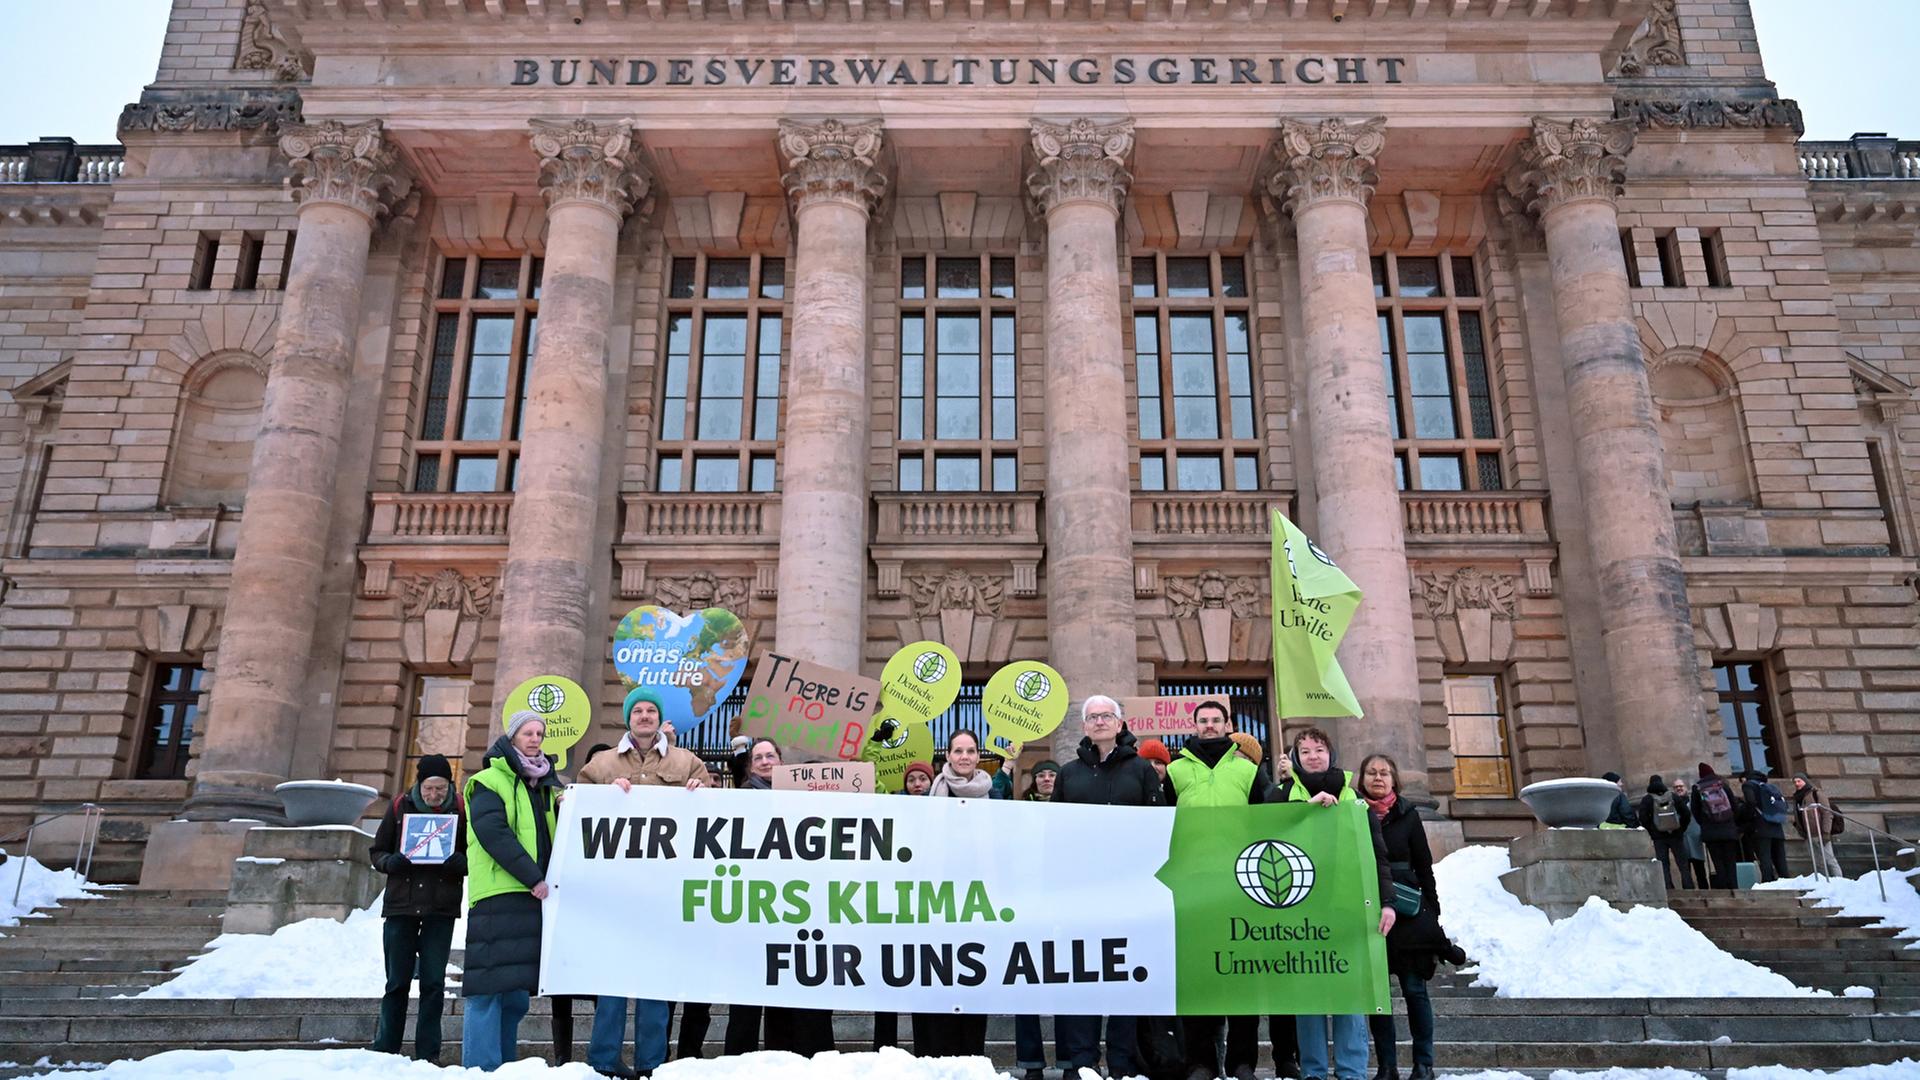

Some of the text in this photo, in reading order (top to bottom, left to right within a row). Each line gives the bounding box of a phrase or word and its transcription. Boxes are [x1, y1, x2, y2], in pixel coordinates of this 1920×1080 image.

[511, 58, 1405, 86] BUNDESVERWALTUNGSGERICHT
[617, 647, 680, 664] omas
[678, 657, 702, 672] for
[638, 666, 704, 686] future
[897, 673, 935, 702] Deutsche
[788, 696, 824, 721] no
[845, 686, 869, 712] is
[883, 681, 932, 717] Umwelthilfe
[1000, 694, 1044, 719] Deutsche
[1155, 701, 1178, 717] EIN
[545, 715, 572, 725] tsche
[987, 703, 1044, 735] Umwelthilfe
[1159, 717, 1196, 731] KLIMAS
[543, 726, 580, 739] elthilfe
[838, 721, 864, 760] B
[879, 749, 917, 763] eutsche
[821, 767, 844, 781] EIN
[581, 816, 913, 863] WIR KLAGEN.
[682, 864, 1016, 925] FÜRS KLIMA.
[1229, 917, 1331, 942] Deutsche
[765, 928, 1149, 987] FÜR UNS ALLE.
[1214, 950, 1350, 975] Umwelthilfe
